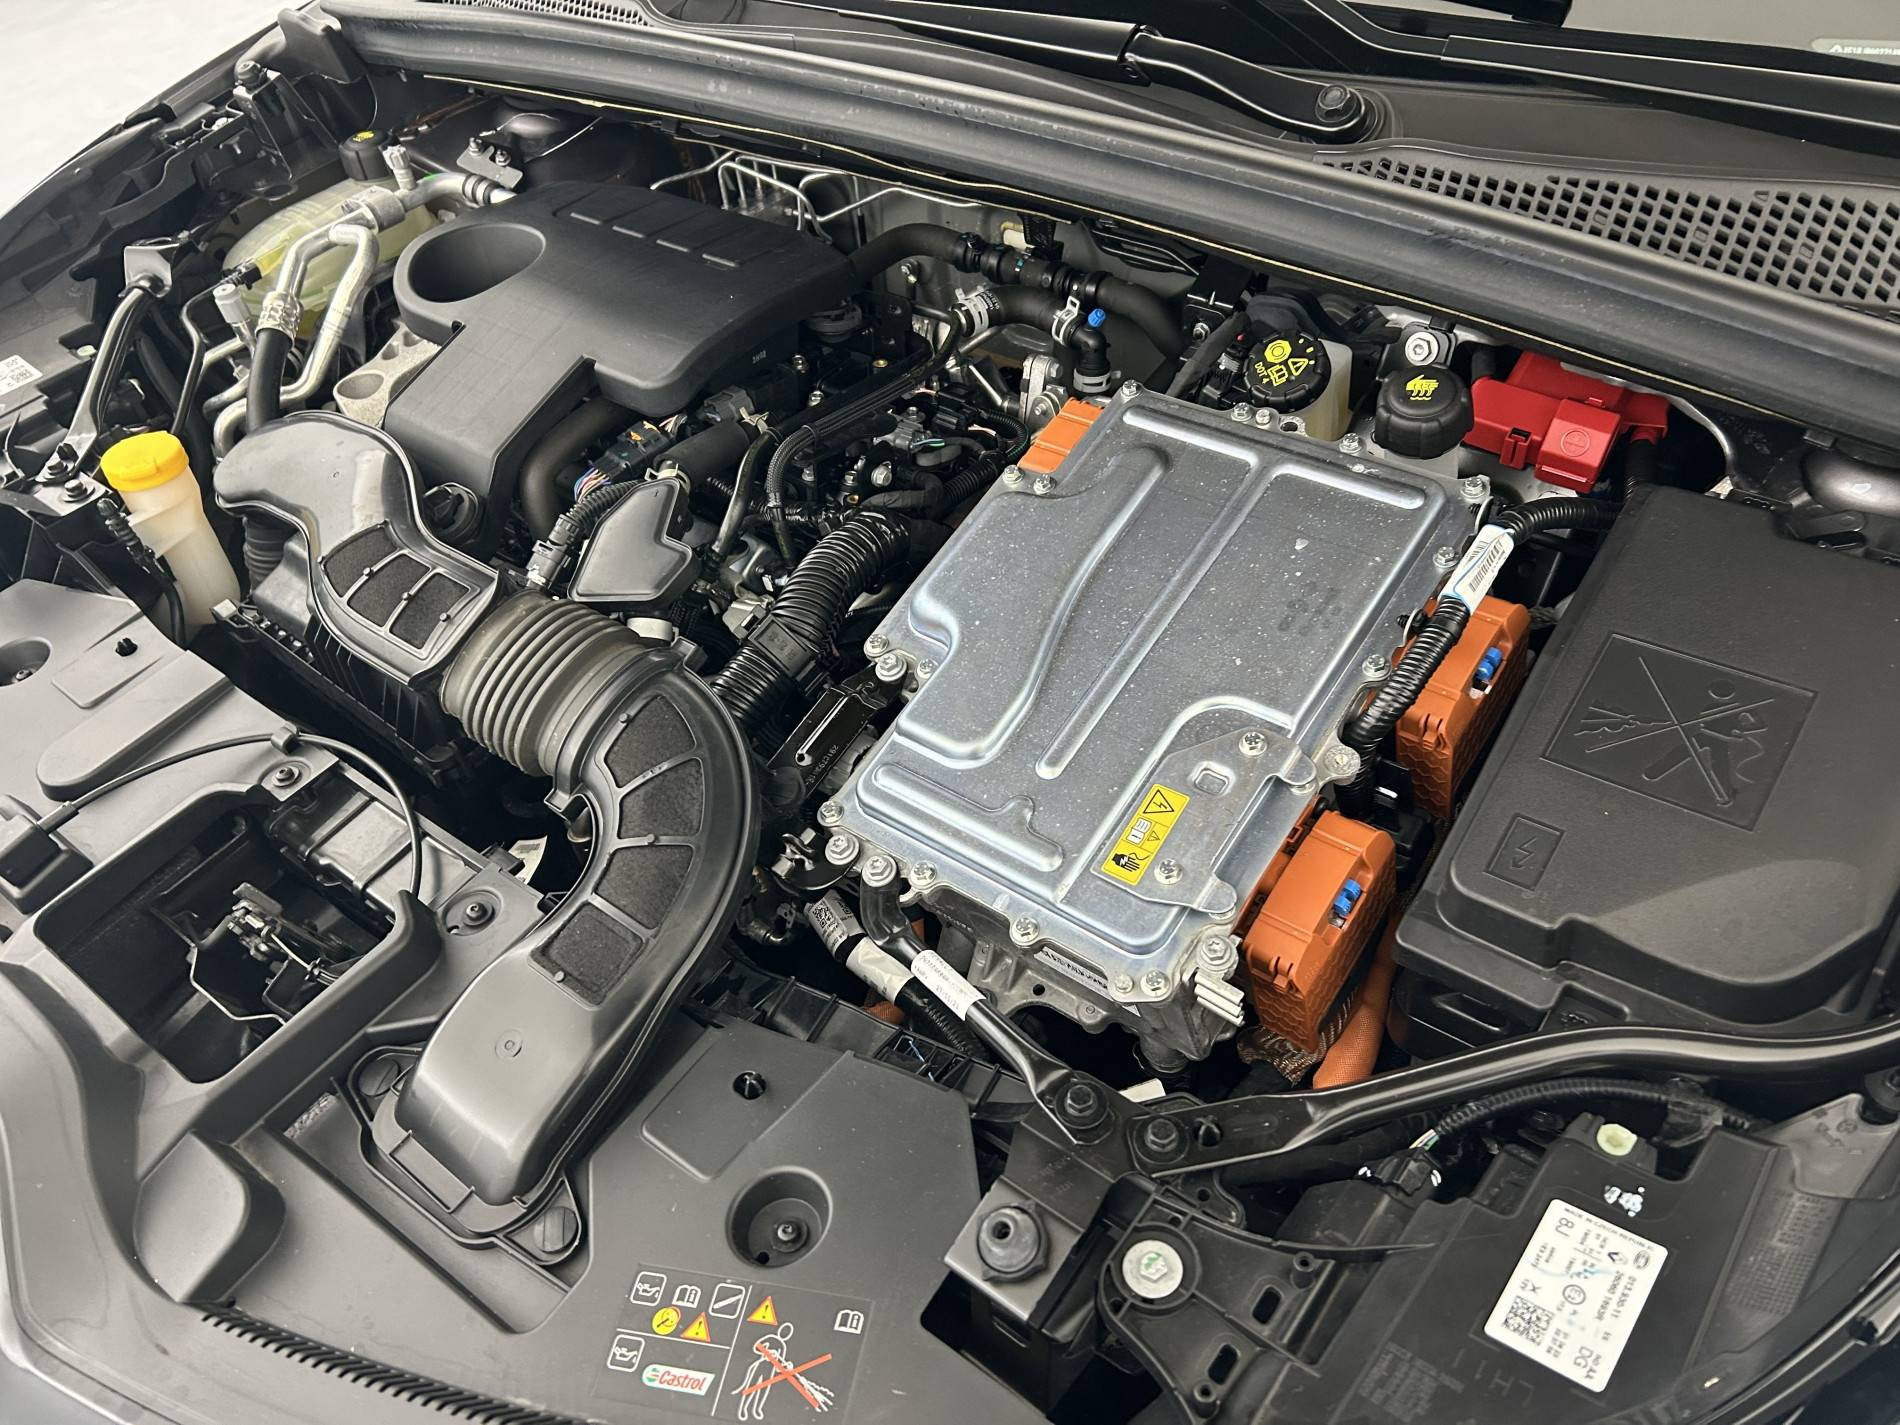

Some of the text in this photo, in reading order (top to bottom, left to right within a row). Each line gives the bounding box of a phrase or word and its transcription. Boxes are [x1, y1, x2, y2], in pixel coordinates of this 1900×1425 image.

[1254, 361, 1268, 377] DOT
[1573, 1345, 1594, 1369] DG
[659, 1370, 706, 1391] Castrol
